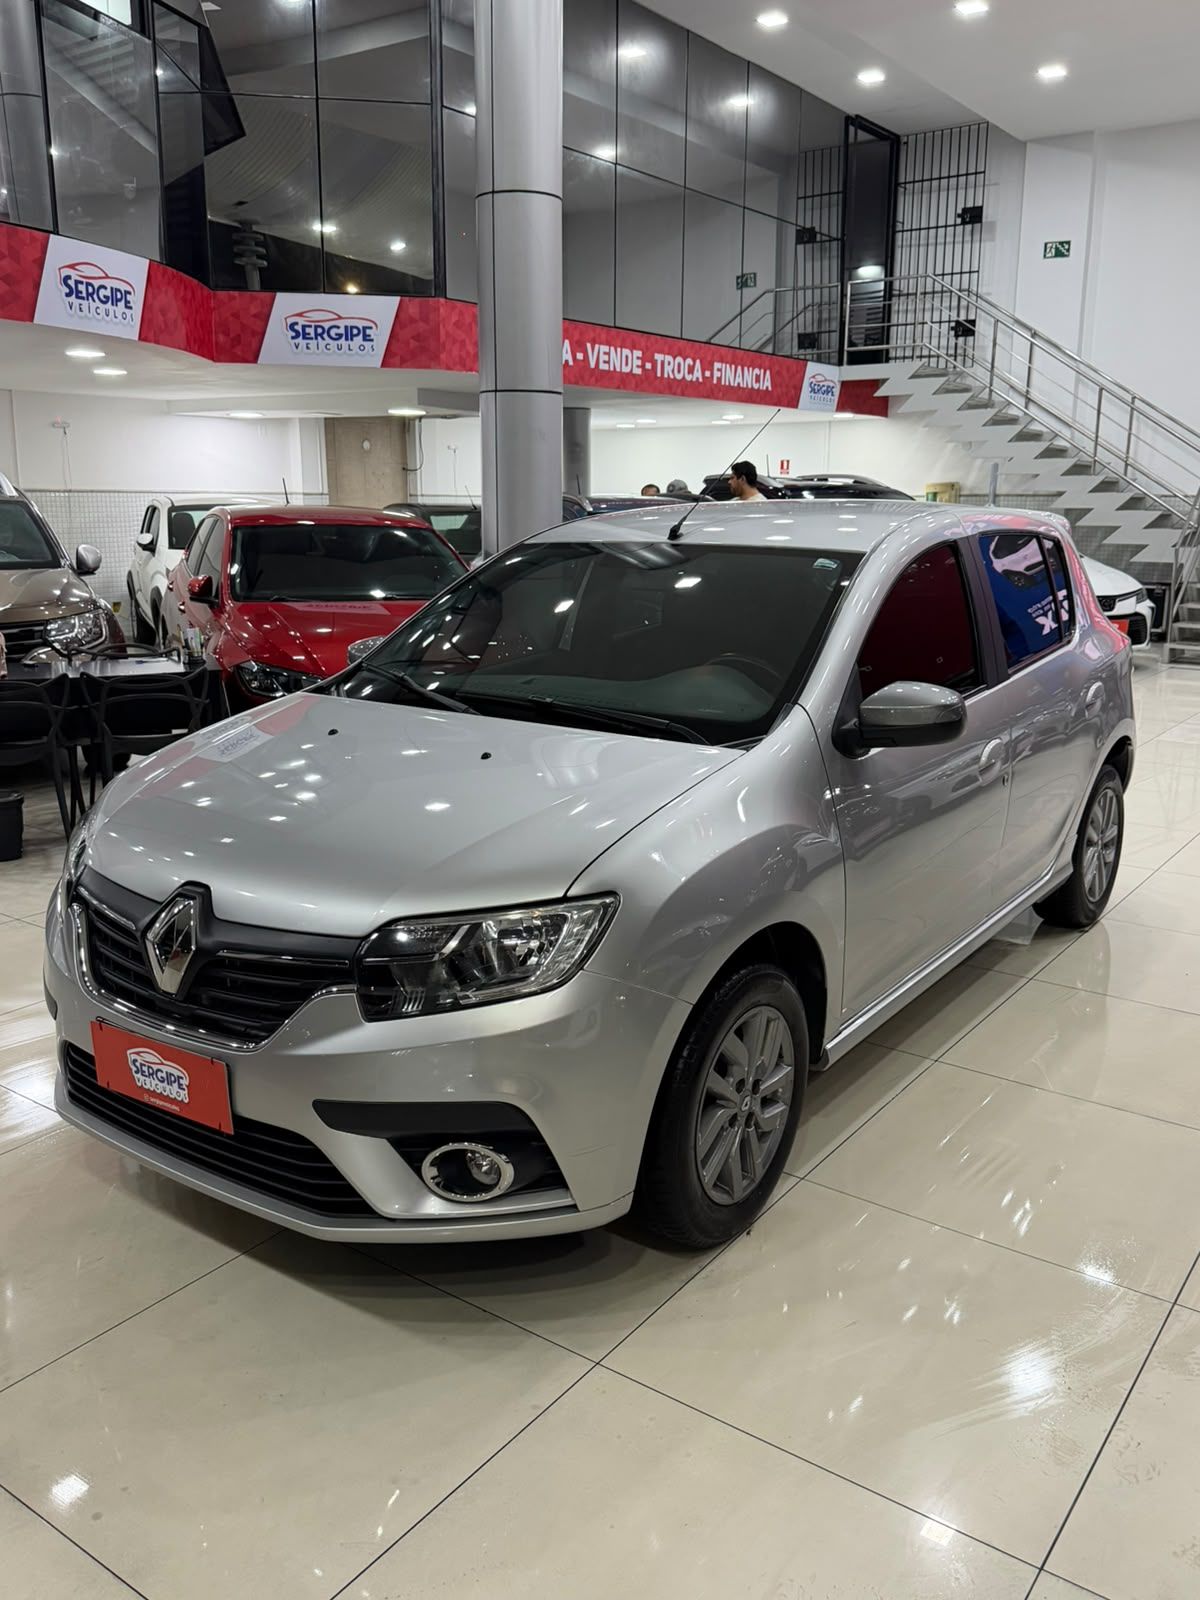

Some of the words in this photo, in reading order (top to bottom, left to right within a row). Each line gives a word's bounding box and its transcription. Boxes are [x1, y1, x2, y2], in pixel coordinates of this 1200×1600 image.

[62, 274, 133, 310] SERGIPE
[68, 300, 134, 323] VEÍCULOS
[288, 321, 375, 342] SERGIPE
[586, 342, 643, 375] VENDE
[654, 352, 703, 383] TROCA
[713, 361, 772, 391] FINANCIA
[809, 381, 835, 397] SERGIPE
[132, 1058, 186, 1091] SERGIPE
